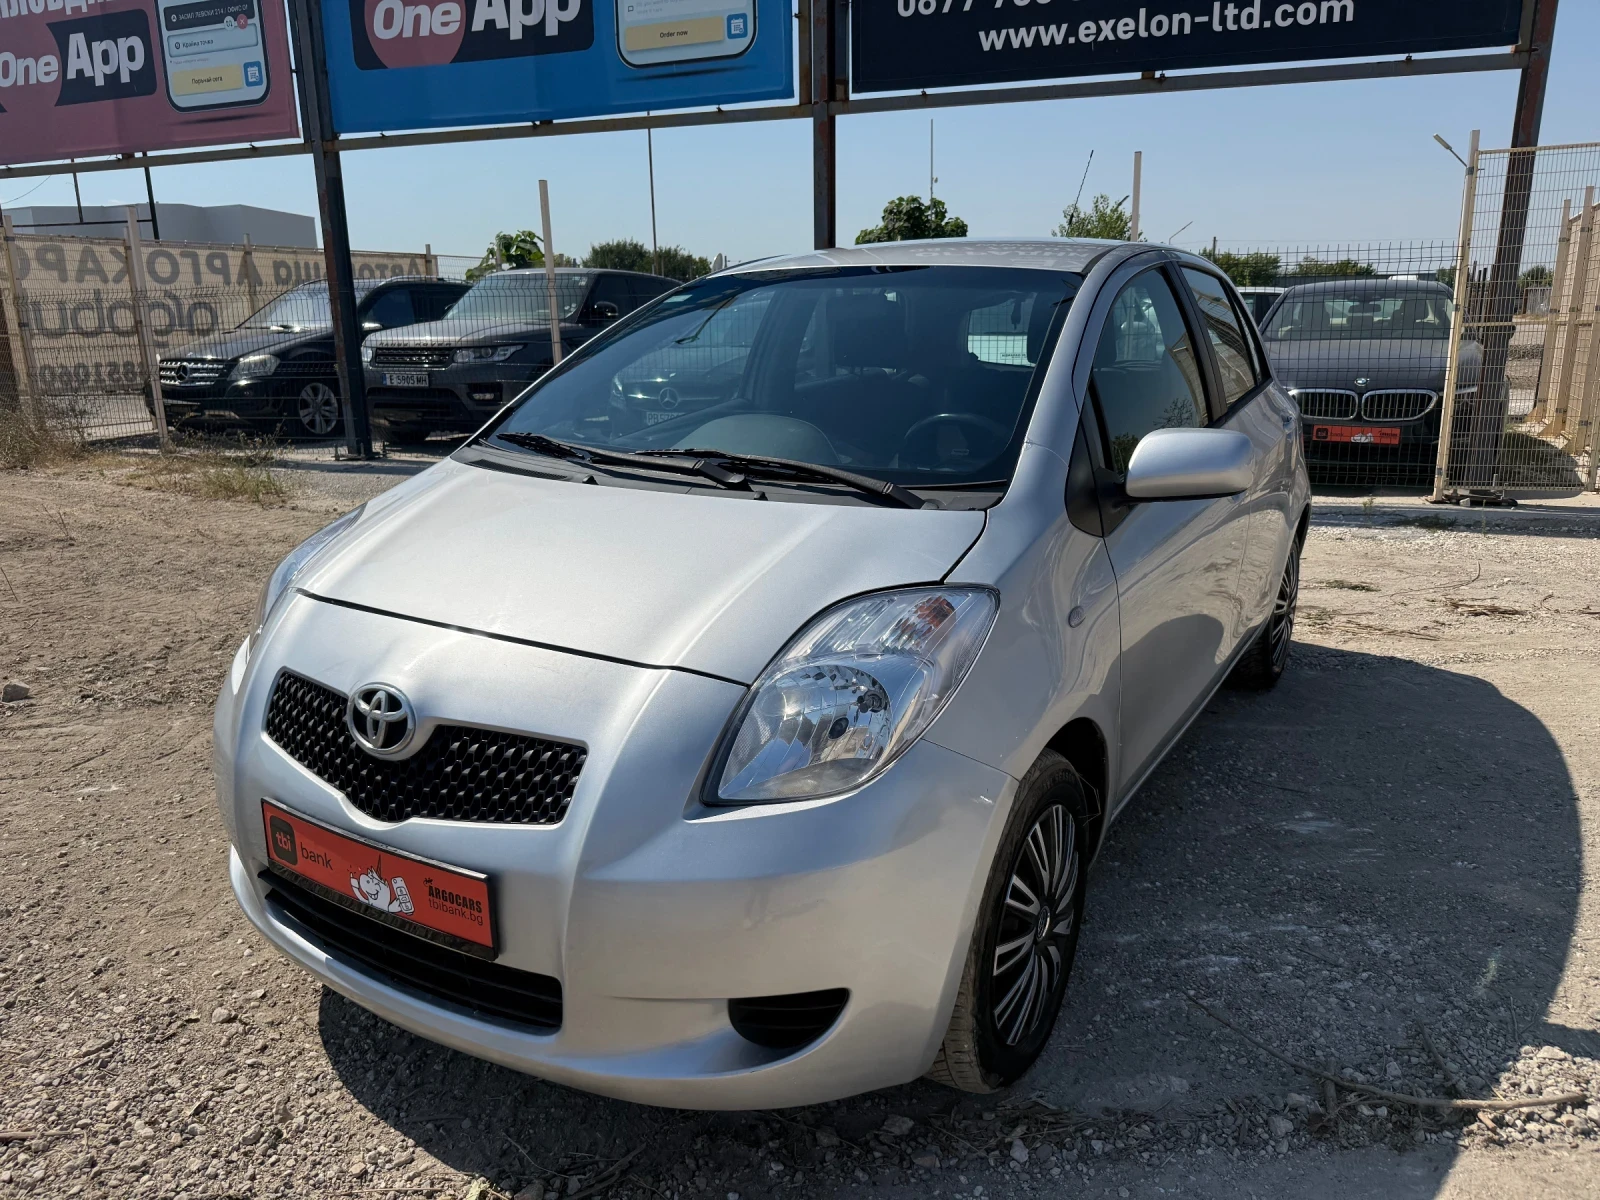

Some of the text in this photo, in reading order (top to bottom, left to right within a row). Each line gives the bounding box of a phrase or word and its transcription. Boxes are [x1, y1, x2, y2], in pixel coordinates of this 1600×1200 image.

[373, 0, 581, 40] One App
[979, 0, 1354, 51] www.exelon-ltd.com
[0, 32, 145, 87] One App
[275, 831, 333, 870] tbi bank
[428, 885, 482, 913] ARGOCARS
[428, 898, 483, 926] tbibank.bg
